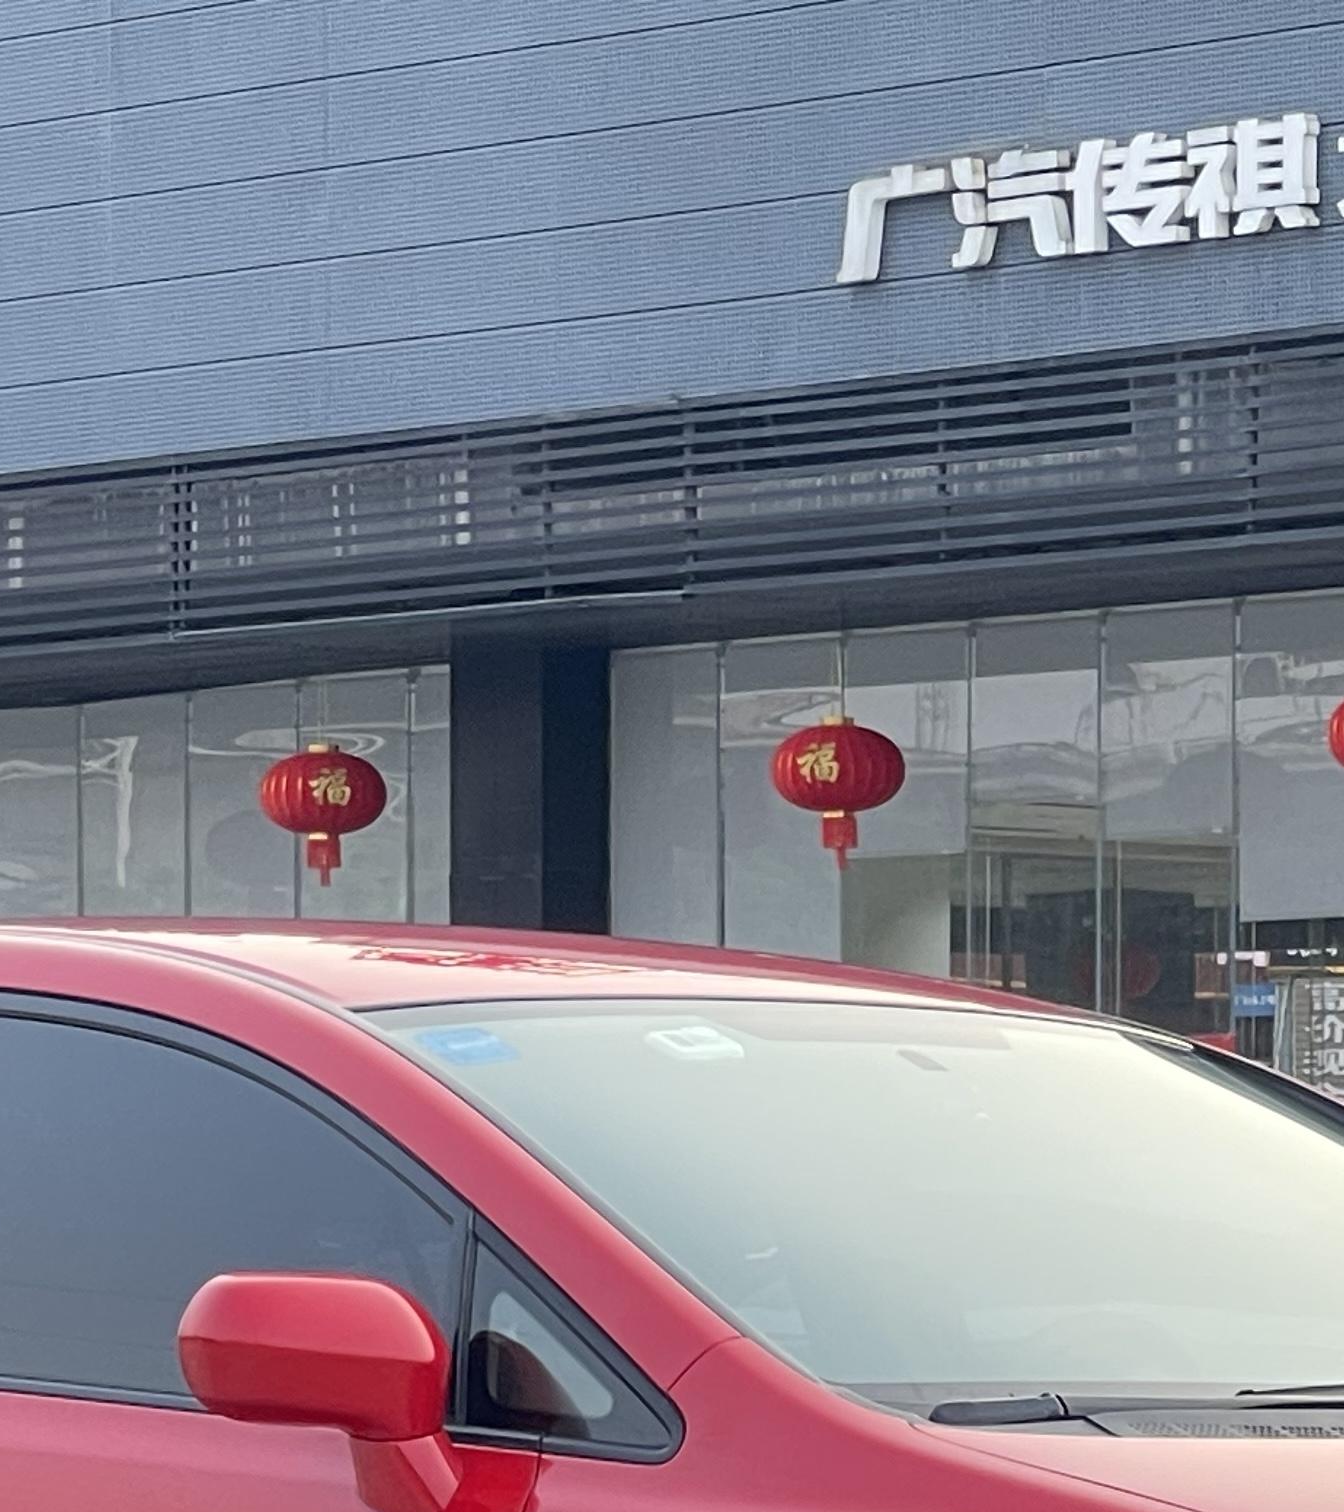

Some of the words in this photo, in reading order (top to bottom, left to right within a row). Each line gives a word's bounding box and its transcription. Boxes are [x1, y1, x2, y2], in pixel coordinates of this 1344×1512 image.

[836, 112, 1321, 284] 广汽传祺
[796, 741, 840, 785] 福
[308, 767, 353, 808] 福
